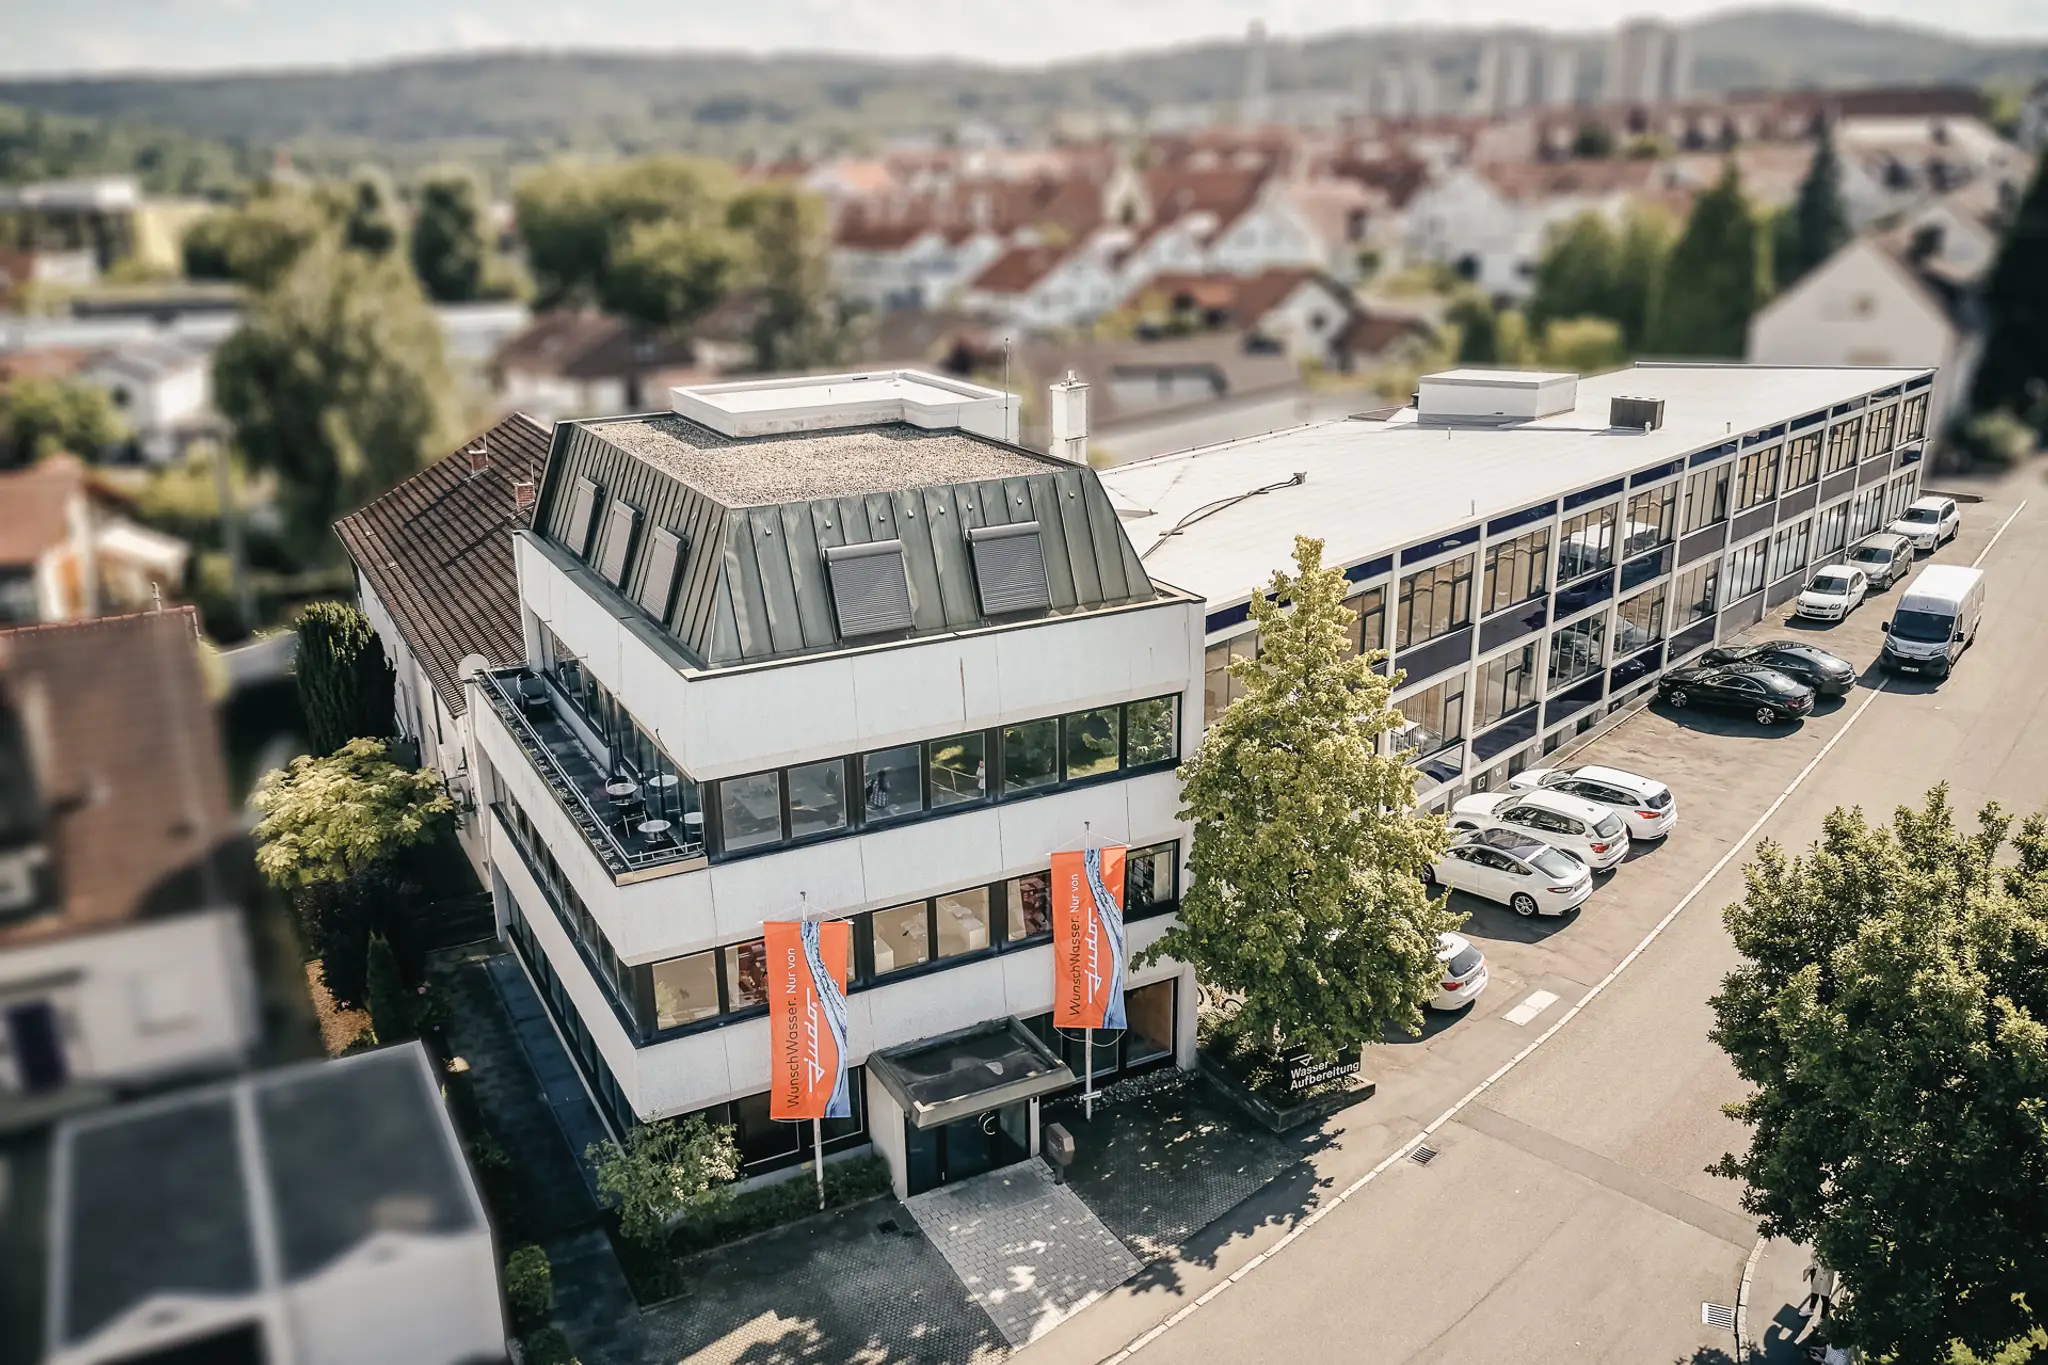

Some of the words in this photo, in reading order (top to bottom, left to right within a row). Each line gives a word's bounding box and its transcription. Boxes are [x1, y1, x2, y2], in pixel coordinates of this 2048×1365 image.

[1071, 873, 1079, 892] von
[1069, 893, 1080, 913] Nur
[787, 948, 796, 970] von
[786, 972, 797, 994] Nur
[786, 997, 800, 1109] WunschWasser.
[1290, 1062, 1360, 1091] Aufbereitung
